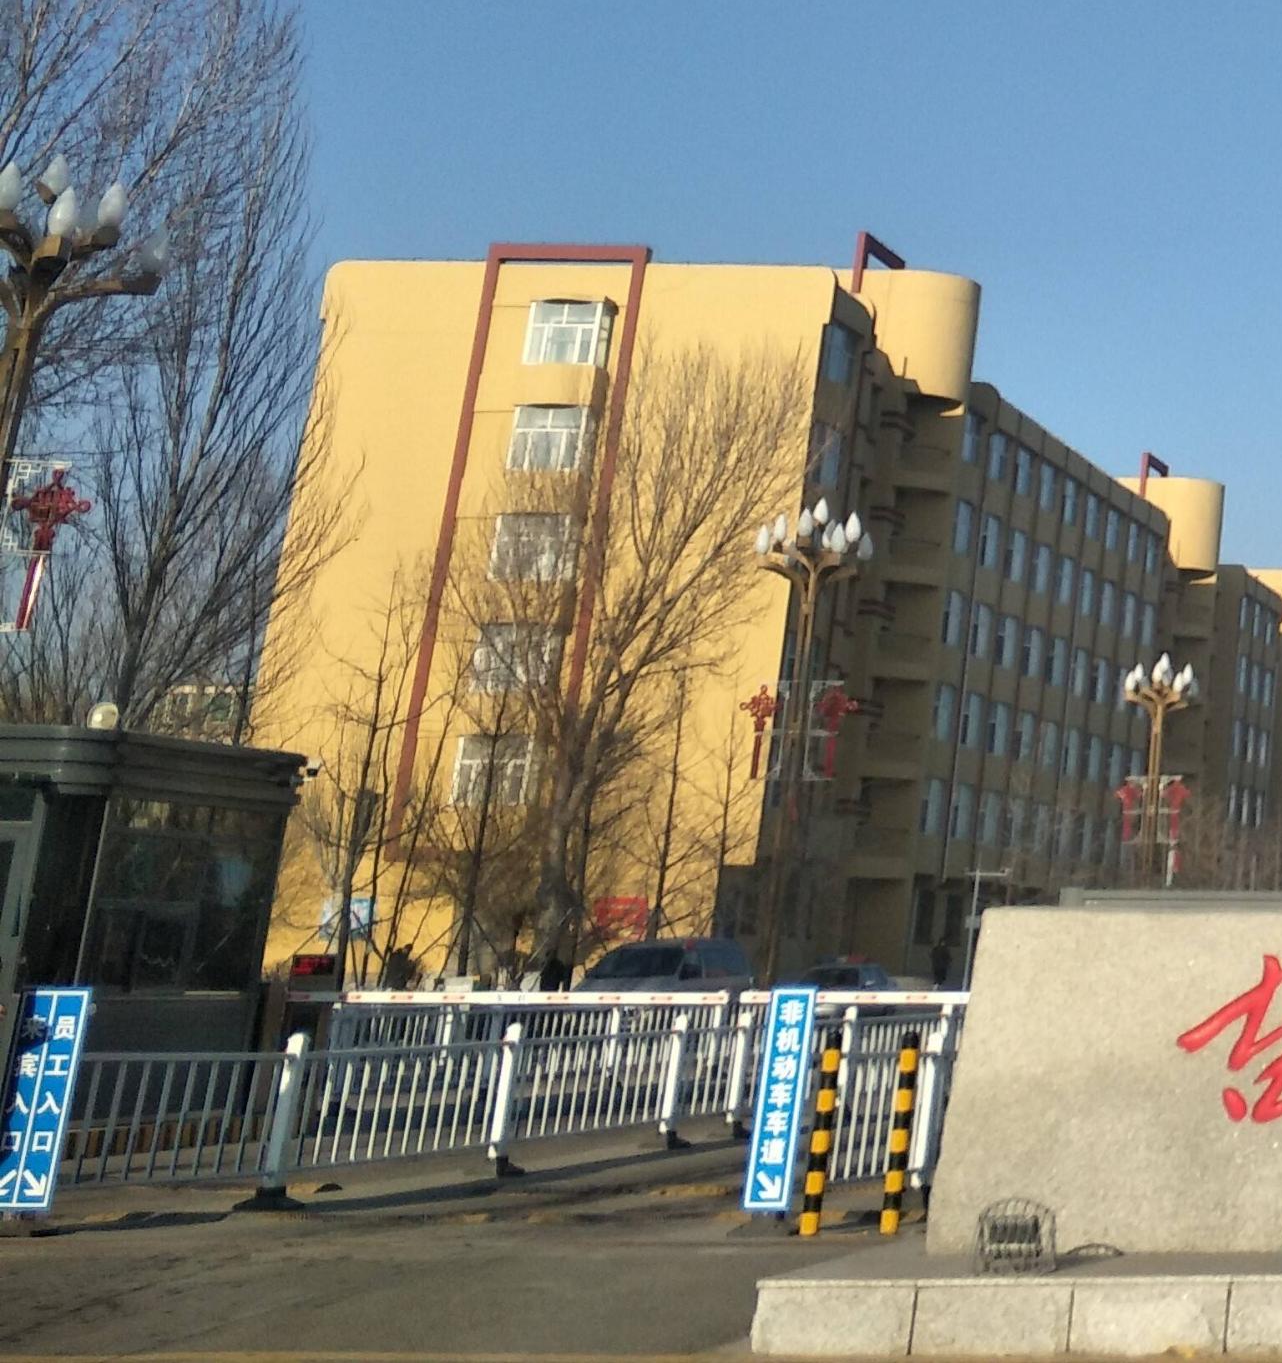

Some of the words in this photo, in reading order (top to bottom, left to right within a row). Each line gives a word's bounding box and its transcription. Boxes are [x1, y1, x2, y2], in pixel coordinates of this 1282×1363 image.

[31, 1015, 76, 1152] 员工入口
[758, 999, 805, 1165] 非机动车车道
